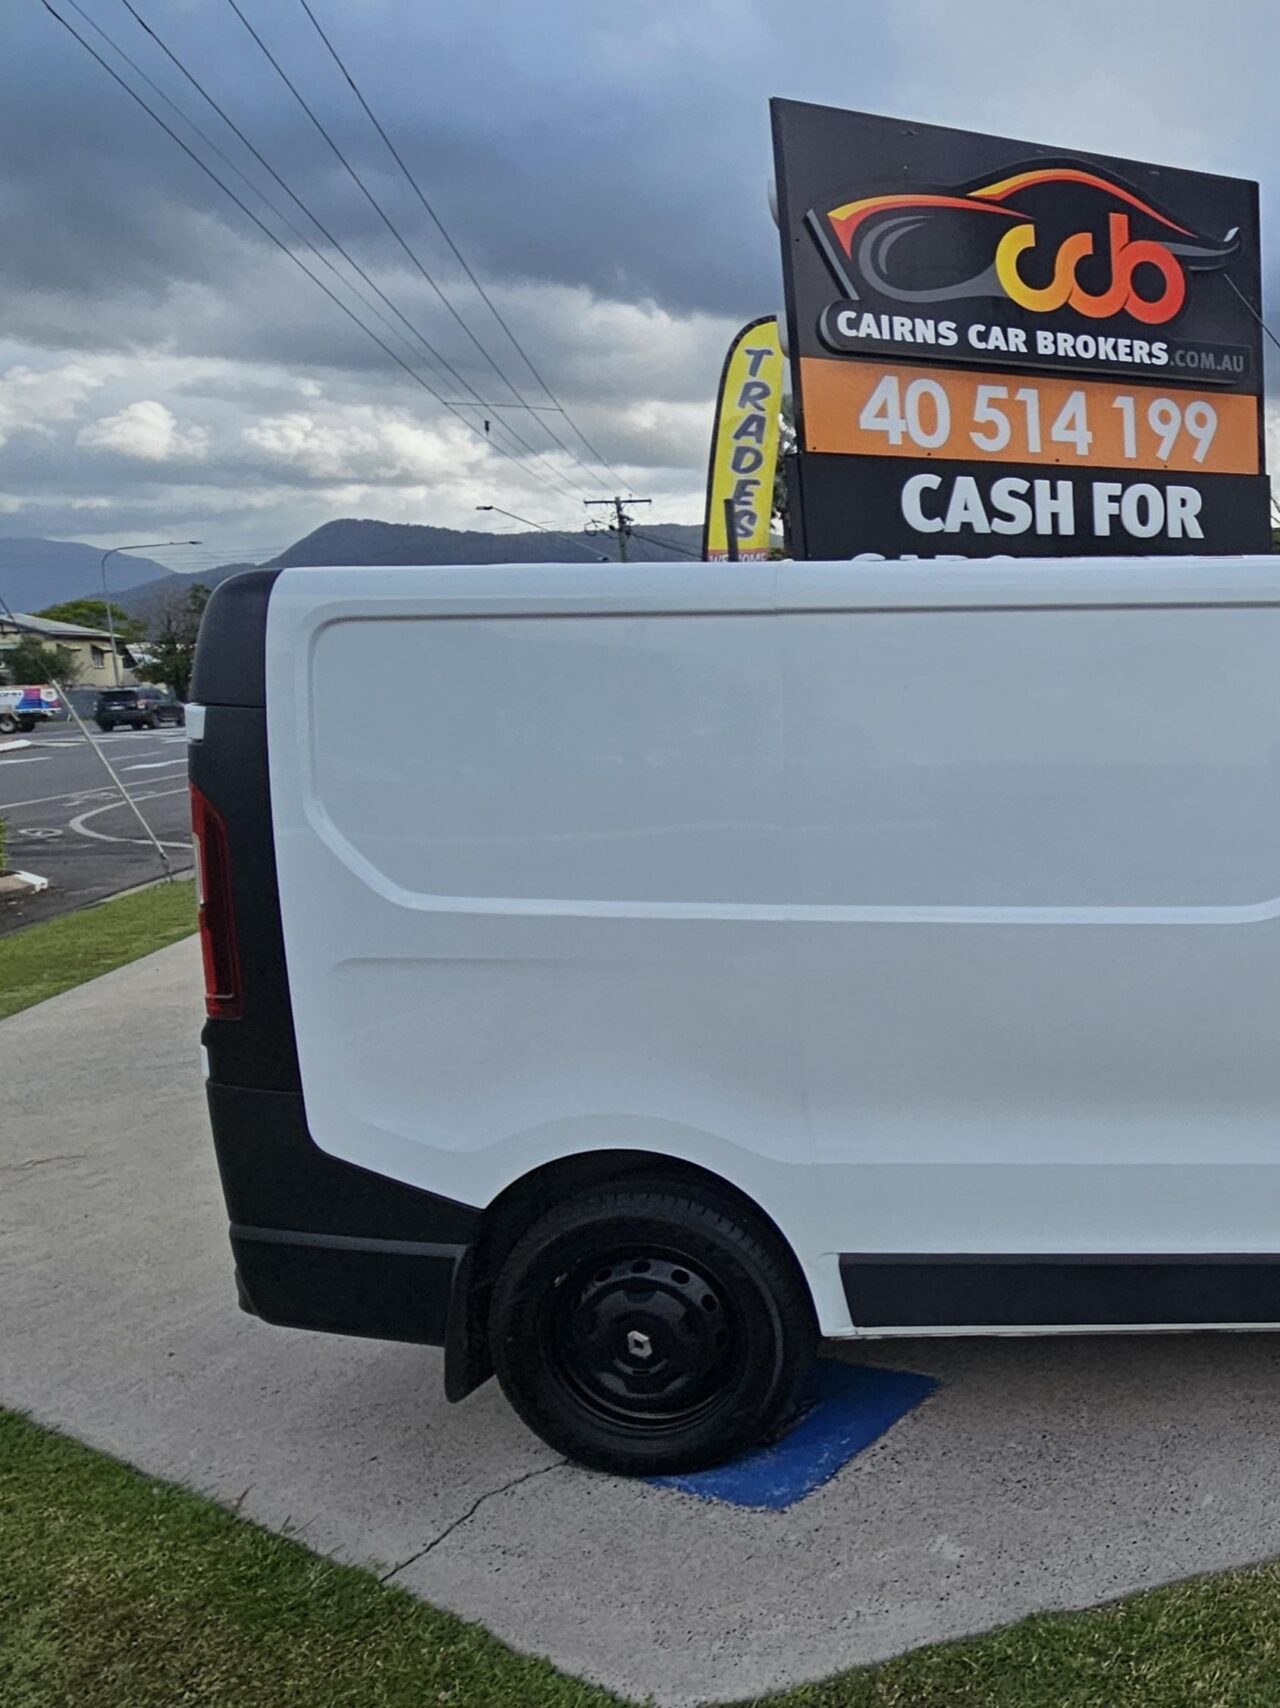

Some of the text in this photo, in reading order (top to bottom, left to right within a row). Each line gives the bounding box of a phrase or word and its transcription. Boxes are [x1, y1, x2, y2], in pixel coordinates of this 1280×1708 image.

[836, 310, 958, 346] CAIRNS
[967, 323, 1027, 354] CAR
[731, 348, 774, 539] TRADES
[859, 375, 1218, 463] 40 514 199
[901, 472, 1206, 539] CASH FOR
